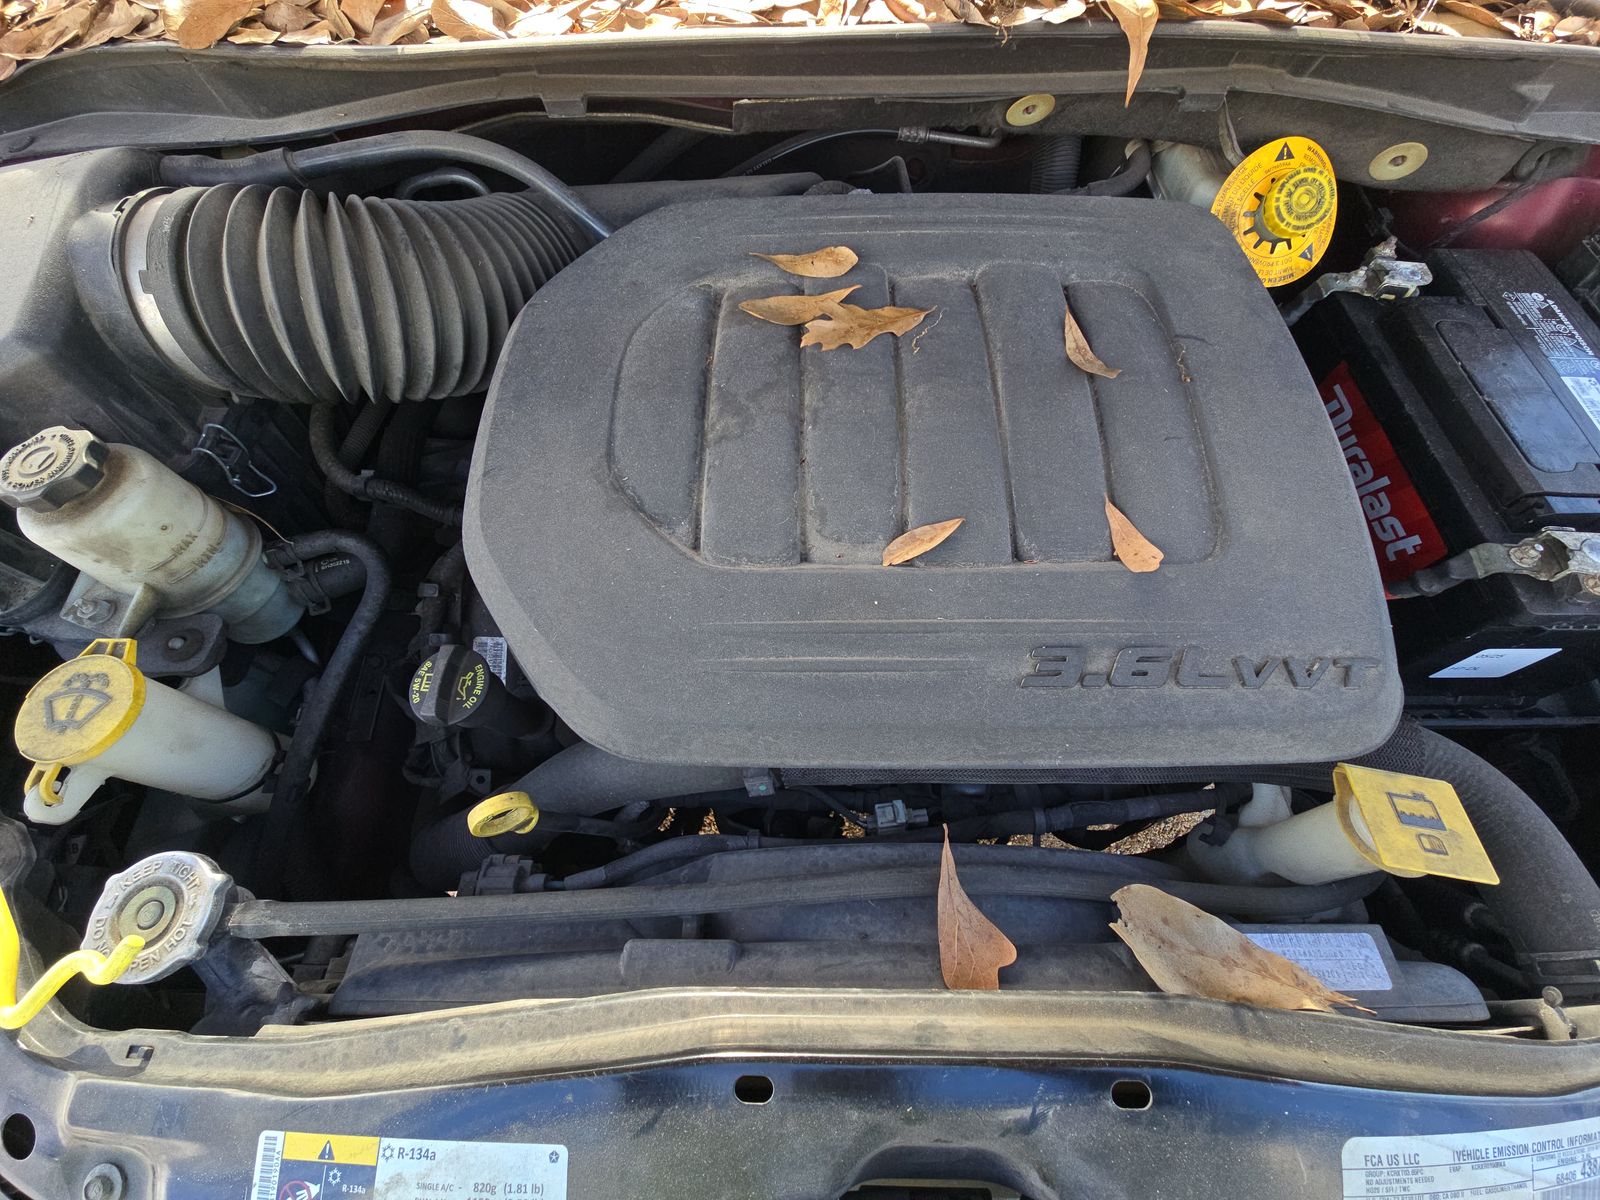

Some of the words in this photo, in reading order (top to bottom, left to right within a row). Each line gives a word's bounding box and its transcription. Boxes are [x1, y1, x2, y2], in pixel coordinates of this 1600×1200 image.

[1325, 383, 1423, 562] Duralast
[418, 660, 433, 677] SAE
[473, 663, 486, 696] ENGINE
[412, 677, 422, 704] 5W-20
[462, 696, 477, 709] OIL
[119, 860, 163, 890] KEEP
[171, 860, 202, 891] TIGHT
[92, 916, 109, 941] DO
[167, 920, 193, 952] HOT
[397, 1146, 436, 1161] R-134a
[1455, 1147, 1489, 1162] VEHICLE
[1492, 1143, 1529, 1158] EMISSION
[1531, 1138, 1565, 1153] CONTROL
[1364, 1154, 1383, 1167] FCA
[1386, 1154, 1400, 1166] US
[1403, 1153, 1420, 1165] LLC
[1580, 1158, 1600, 1178] 438
[341, 1184, 366, 1194] R-134a
[416, 1182, 439, 1191] SINGLE
[440, 1182, 454, 1192] A/C
[473, 1182, 497, 1195] 820g
[503, 1182, 528, 1195] (1.81
[531, 1183, 545, 1195] lb)
[1375, 1177, 1414, 1185] ADJUSTMENTS
[1414, 1175, 1435, 1183] NEEDED
